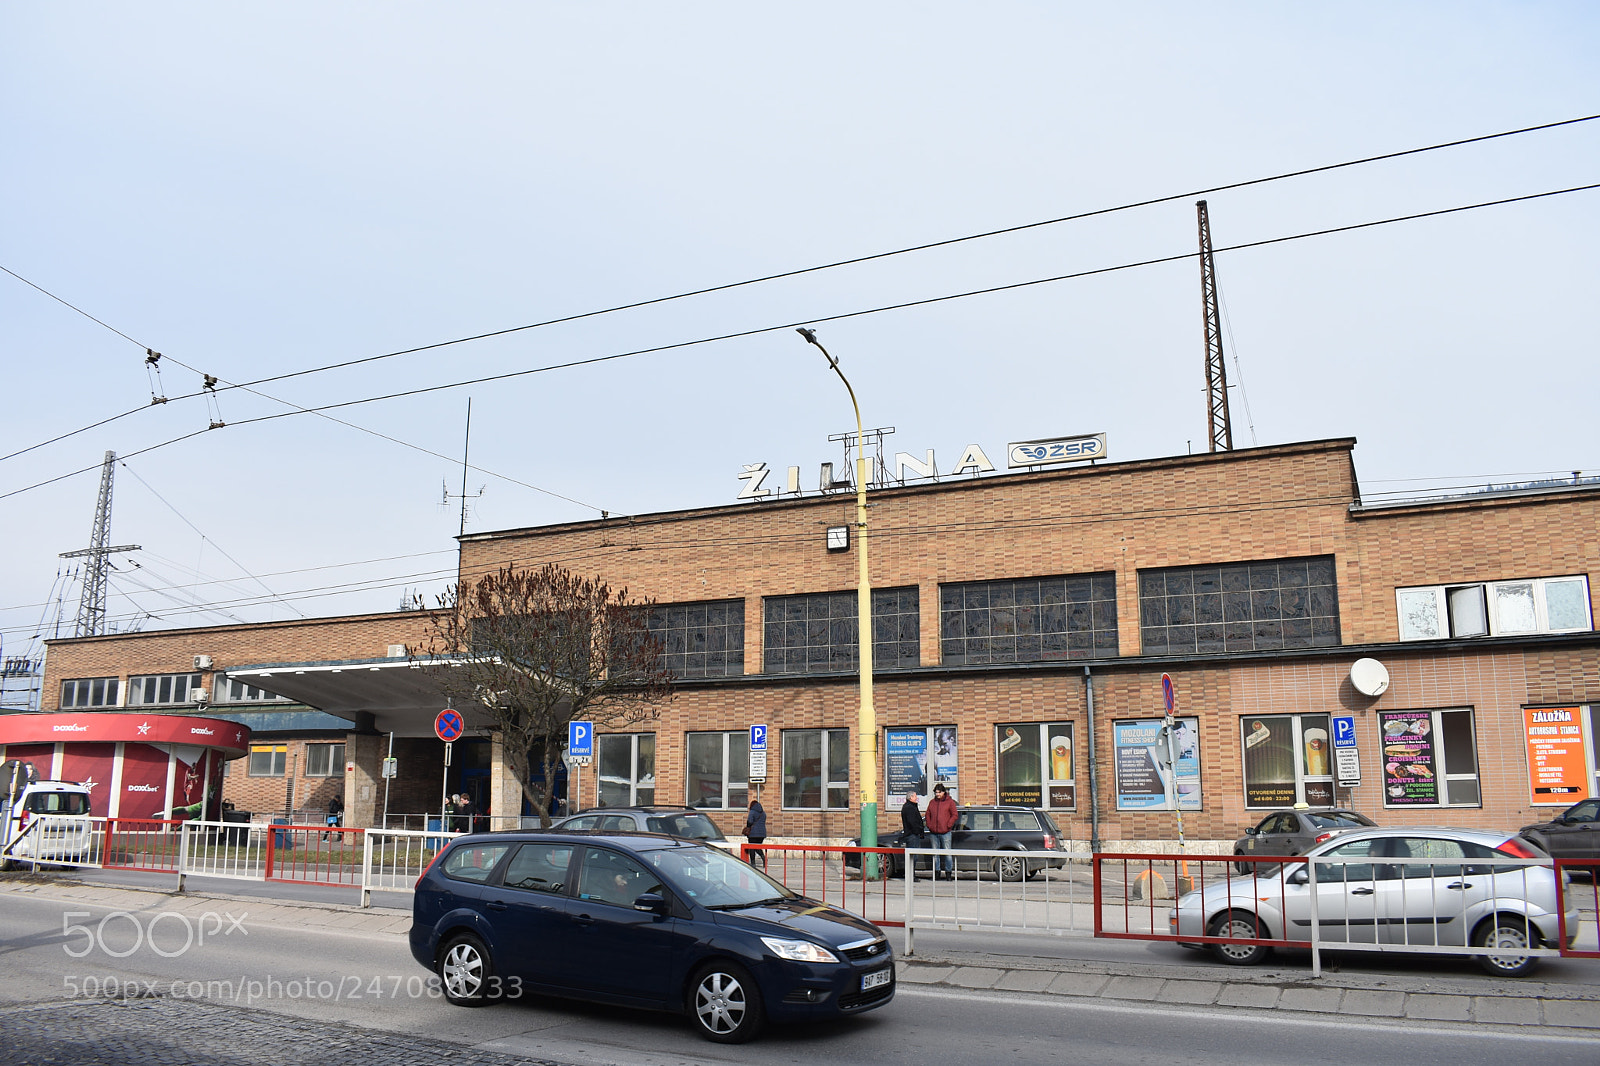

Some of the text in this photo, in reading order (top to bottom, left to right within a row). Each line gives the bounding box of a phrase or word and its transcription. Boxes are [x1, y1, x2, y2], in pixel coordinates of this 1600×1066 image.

[1049, 440, 1097, 458] ŽSR
[737, 443, 995, 500] ŽILINA
[1532, 710, 1573, 722] ZÁLOŽŇA
[575, 726, 587, 745] P
[754, 728, 763, 743] P
[1121, 729, 1156, 738] MOZOLANI
[1338, 721, 1349, 738] P
